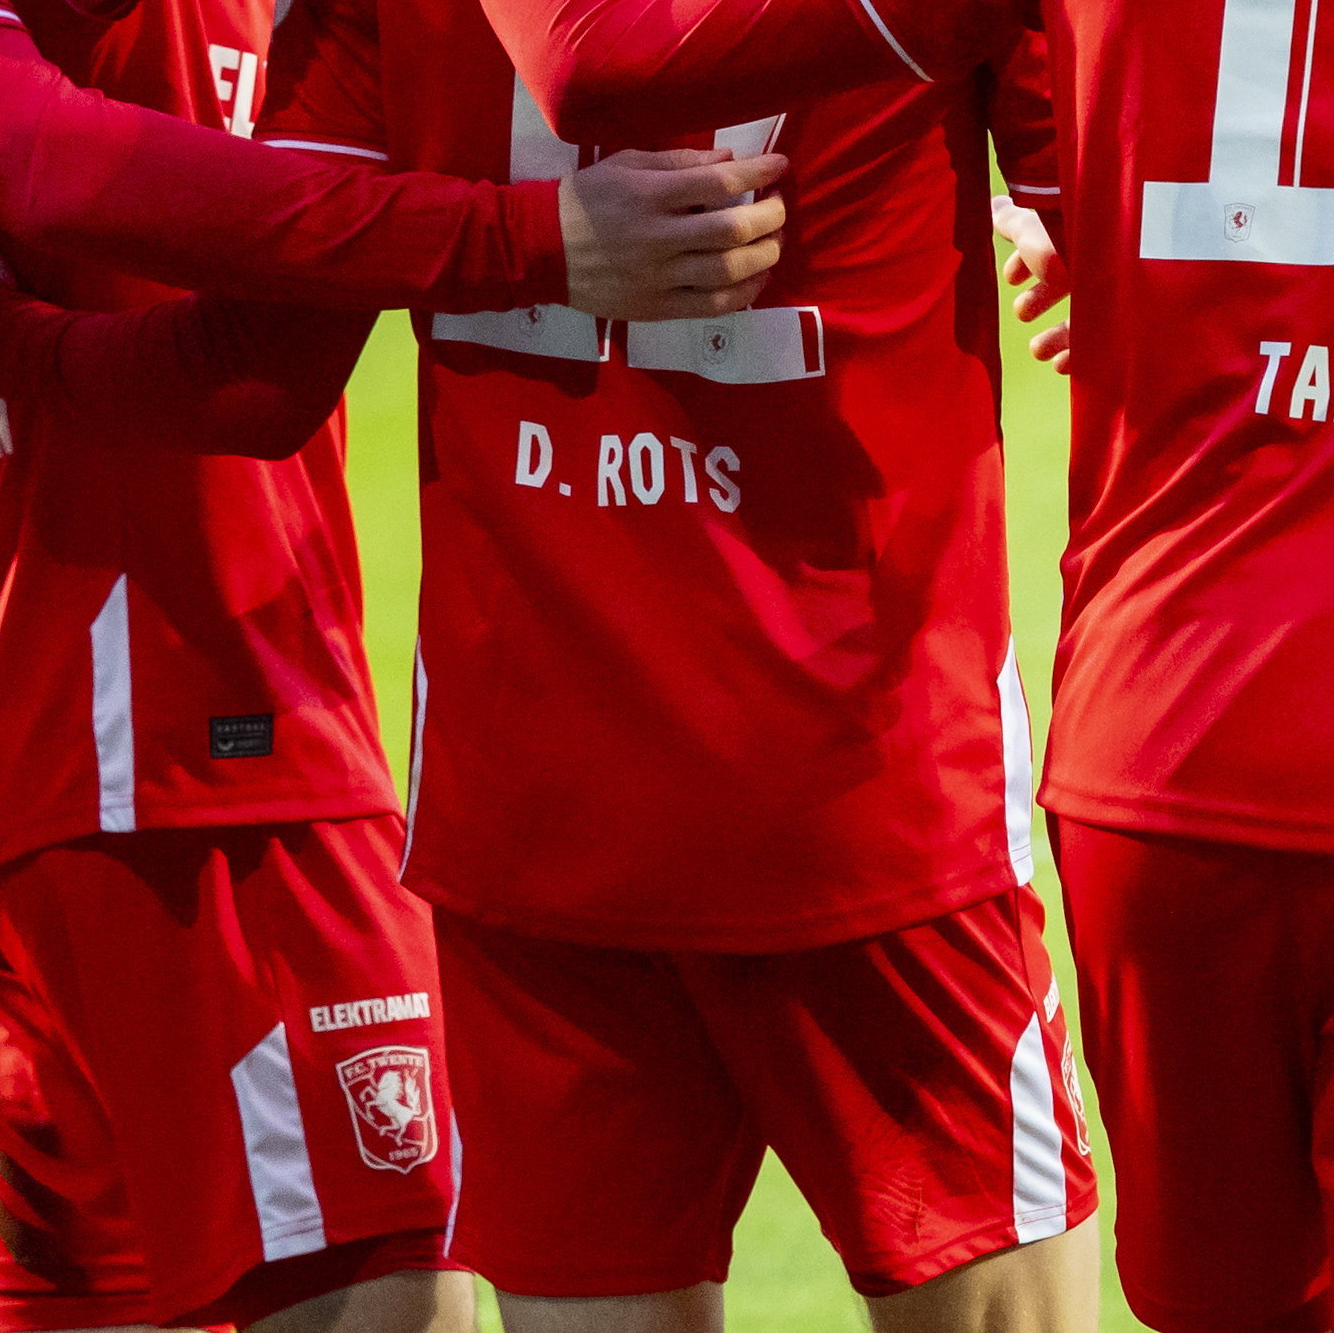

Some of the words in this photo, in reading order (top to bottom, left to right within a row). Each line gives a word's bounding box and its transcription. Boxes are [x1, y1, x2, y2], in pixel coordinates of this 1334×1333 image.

[514, 420, 572, 498] D.
[597, 432, 741, 514] ROTS
[309, 991, 431, 1033] ELEKTRAMAT
